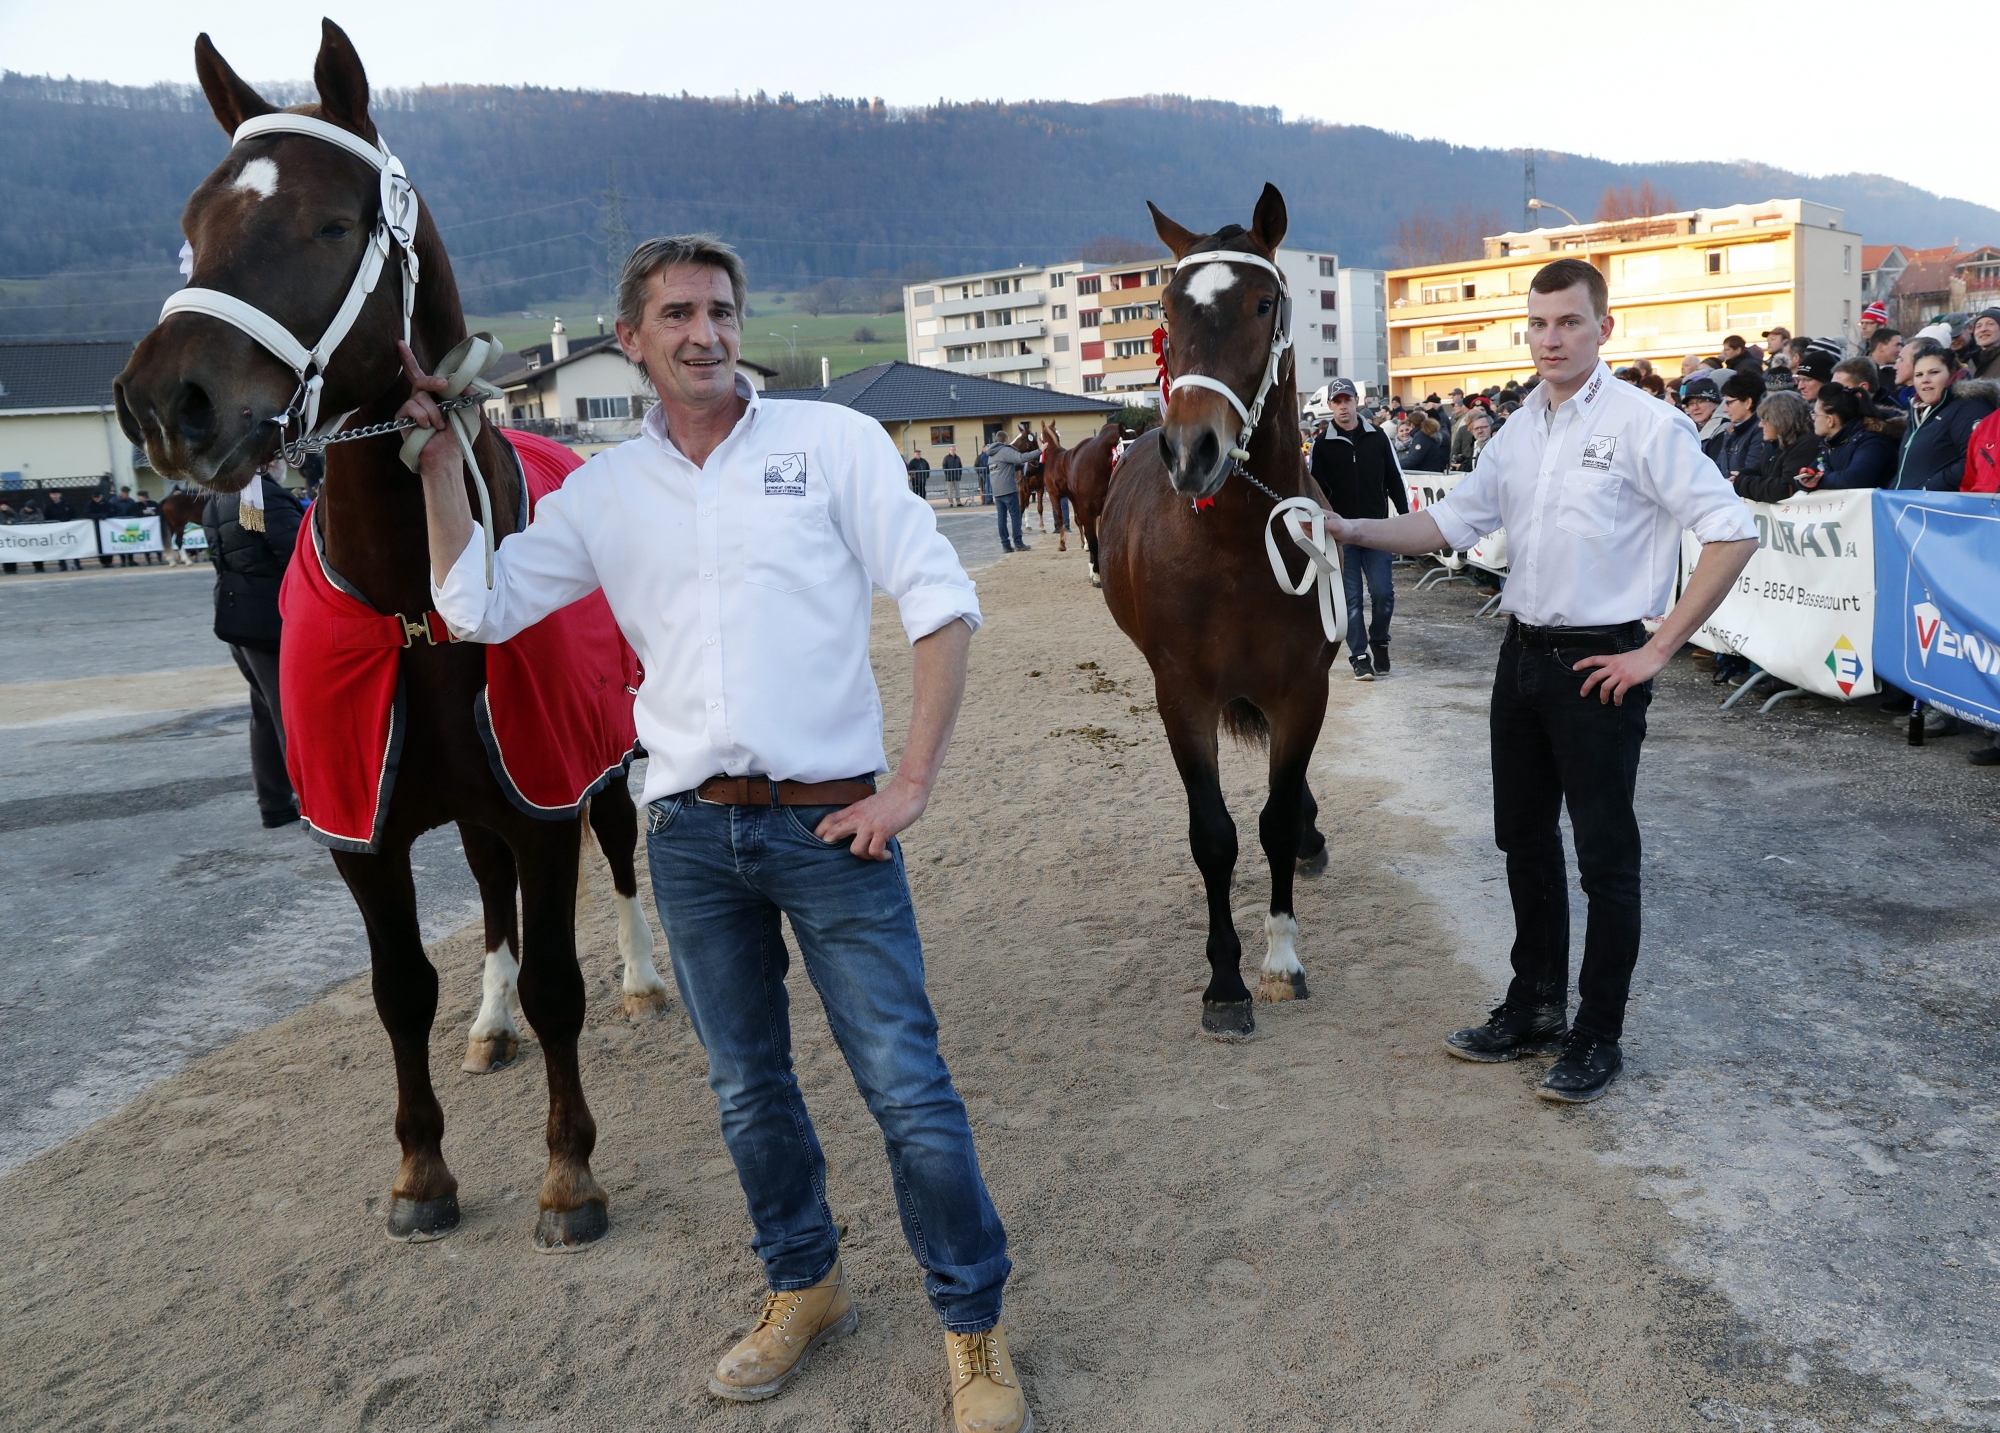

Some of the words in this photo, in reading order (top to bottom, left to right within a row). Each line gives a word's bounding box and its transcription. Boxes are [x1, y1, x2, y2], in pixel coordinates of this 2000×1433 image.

[388, 181, 410, 238] 42
[110, 529, 150, 543] Landi
[1763, 581, 1795, 603] 2854
[1797, 587, 1861, 612] Bassecourt
